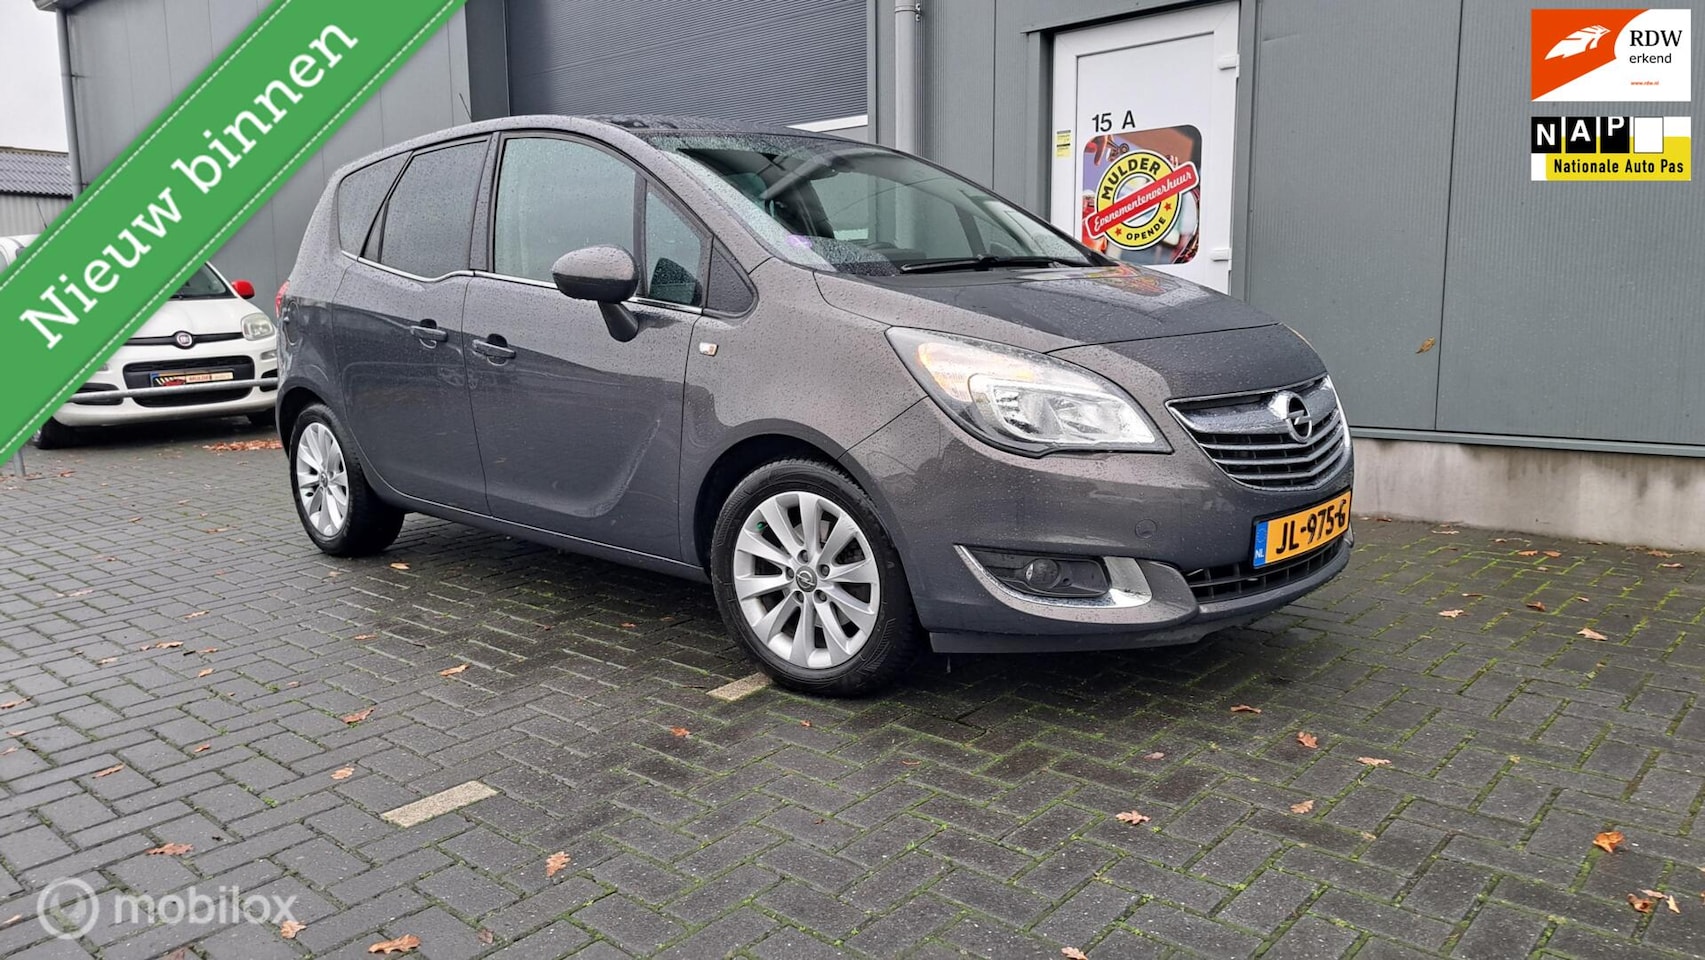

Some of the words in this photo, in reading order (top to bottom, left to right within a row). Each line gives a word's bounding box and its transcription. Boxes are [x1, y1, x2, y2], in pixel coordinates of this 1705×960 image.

[1091, 112, 1112, 132] 15
[1121, 110, 1136, 129] A
[1101, 157, 1161, 200] MULDER
[1094, 171, 1192, 232] Evenementenverhuur
[1126, 216, 1166, 240] OPENDE
[1254, 548, 1265, 559] NL
